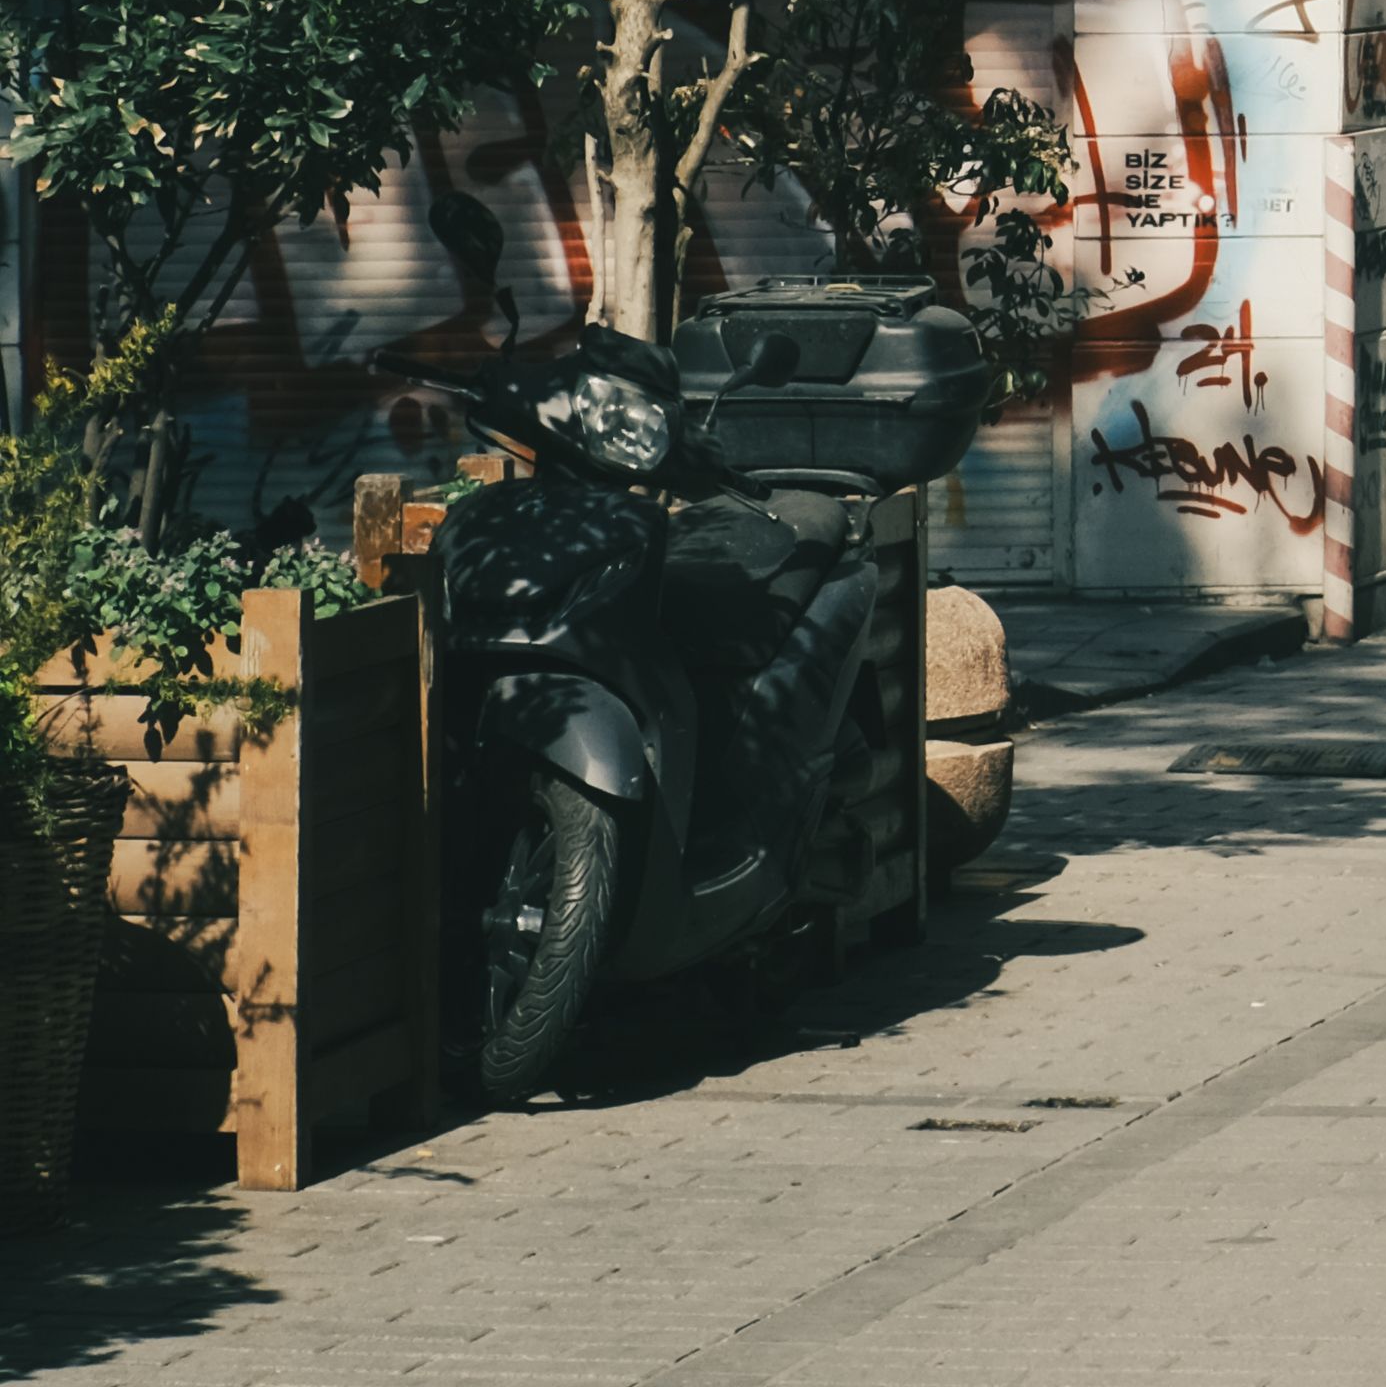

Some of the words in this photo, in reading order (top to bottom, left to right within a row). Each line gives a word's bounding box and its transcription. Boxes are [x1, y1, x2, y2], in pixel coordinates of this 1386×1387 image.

[1125, 149, 1168, 169] BİZ
[1125, 170, 1185, 190] SİZE
[1125, 193, 1161, 209] NE
[1125, 212, 1236, 228] YAPTIK?
